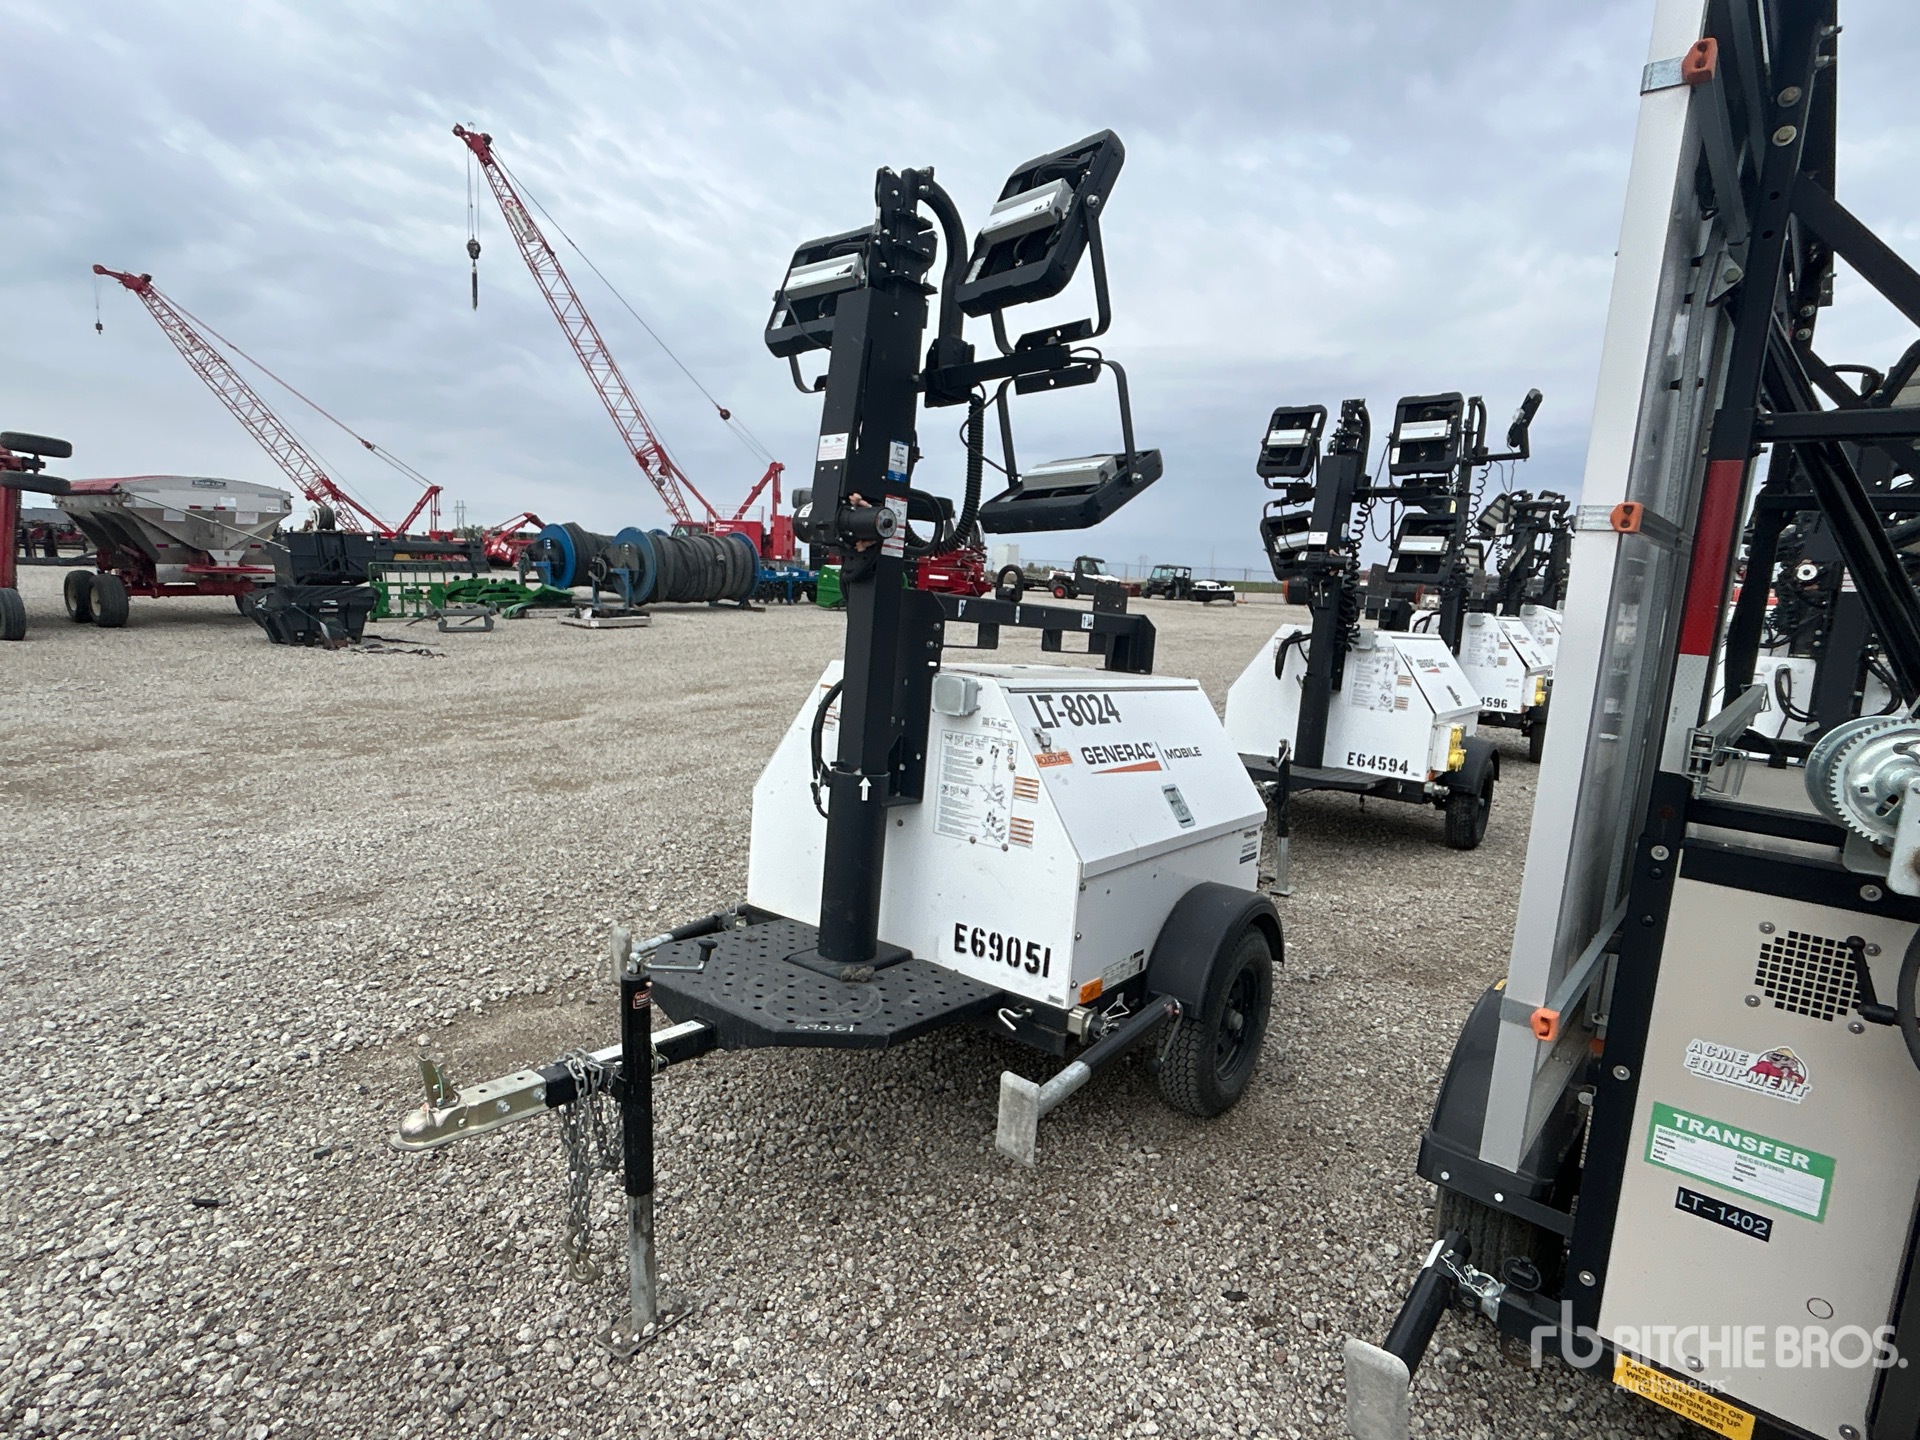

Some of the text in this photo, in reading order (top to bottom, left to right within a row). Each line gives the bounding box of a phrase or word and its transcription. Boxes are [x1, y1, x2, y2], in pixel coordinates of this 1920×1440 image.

[1027, 693, 1122, 729] LT-8024
[1080, 742, 1202, 765] GENERAC MOBILE
[1346, 751, 1409, 775] E64594
[954, 922, 1051, 979] E69051
[1688, 1040, 1750, 1067] ACME
[1685, 1055, 1810, 1098] EQUIPMENT
[1657, 1127, 1697, 1144] SHIPPING
[1672, 1113, 1810, 1170] TRANSFER
[1736, 1153, 1785, 1174] RECEIVING
[1677, 1191, 1769, 1237] LT-1402
[1626, 1361, 1744, 1422] FACE TONGUE EAST OR
[1626, 1370, 1653, 1387] WEST
[1671, 1392, 1704, 1412] BEGIN
[1706, 1408, 1741, 1428] SETUP
[1654, 1392, 1685, 1411] LIGHT
[1687, 1408, 1724, 1431] TOWER
